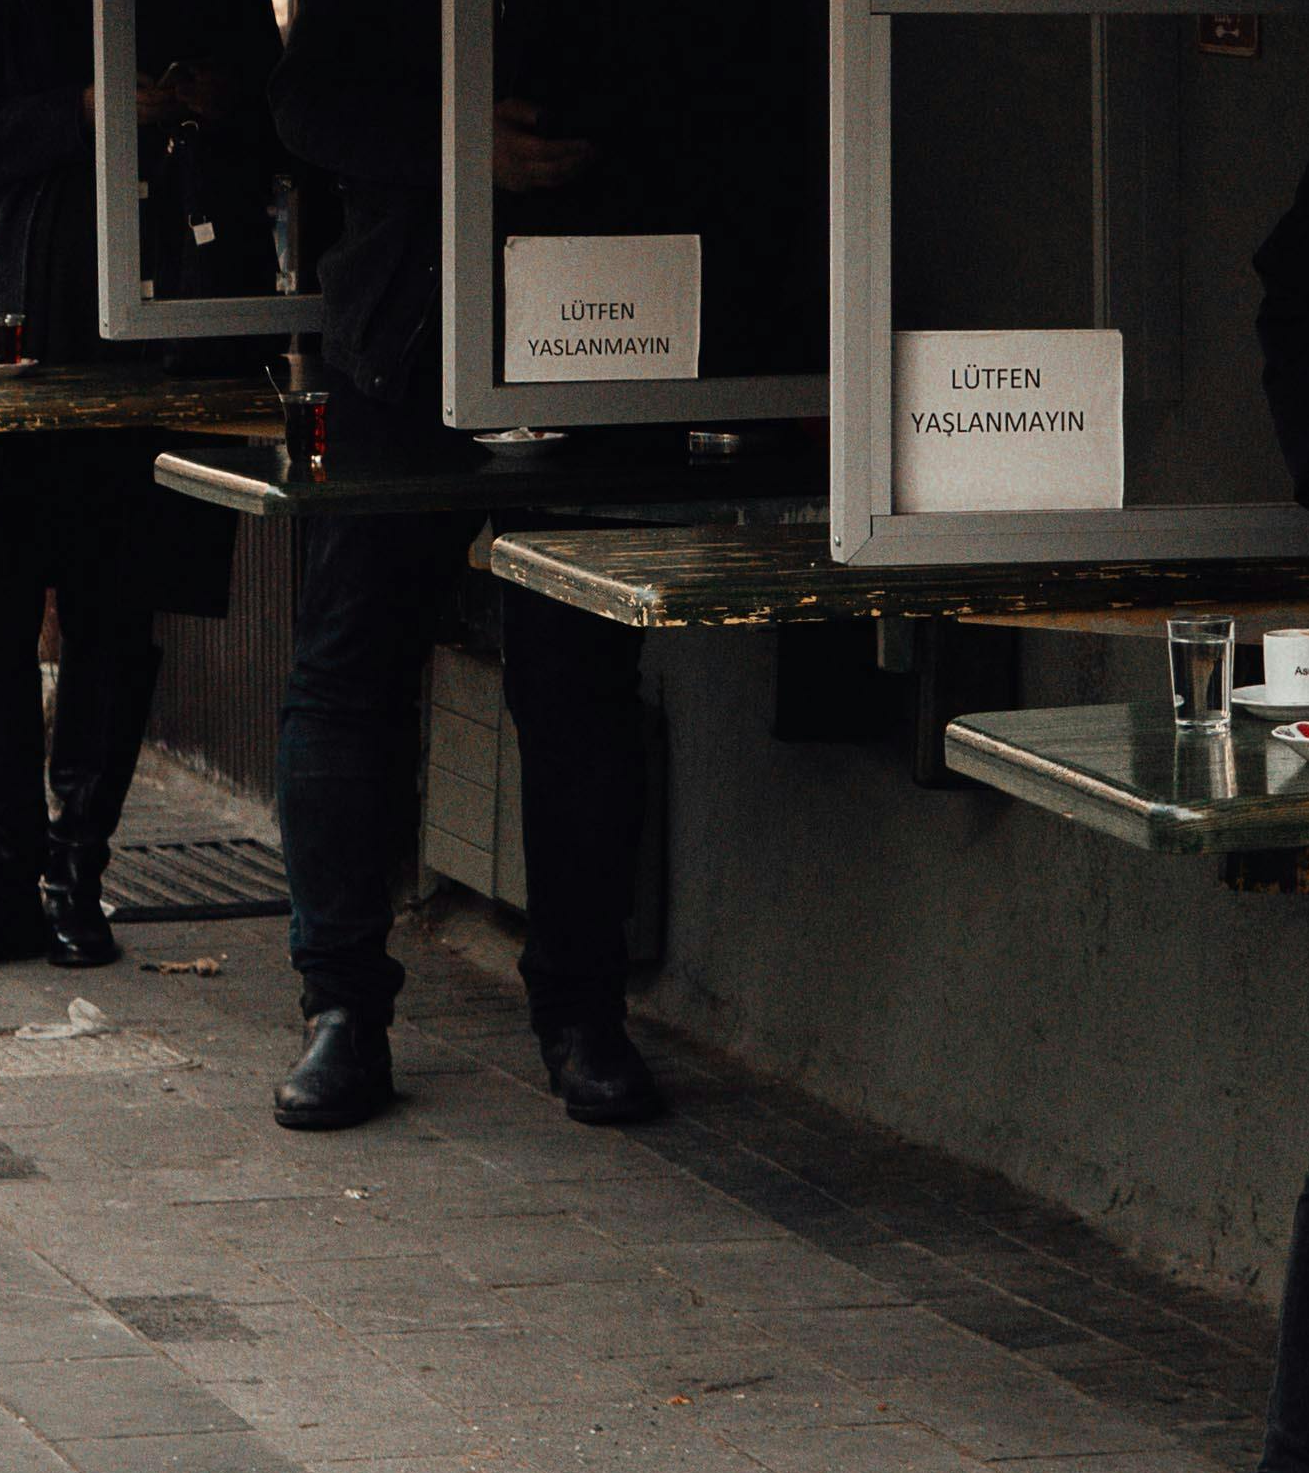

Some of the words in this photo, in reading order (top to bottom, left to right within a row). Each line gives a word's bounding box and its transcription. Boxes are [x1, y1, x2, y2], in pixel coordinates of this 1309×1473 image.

[560, 299, 635, 321] LÜTFEN
[528, 337, 670, 356] YASLANMAYIN
[951, 363, 1041, 389] LÜTFEN
[911, 411, 1085, 437] YAŞLANMAYIN
